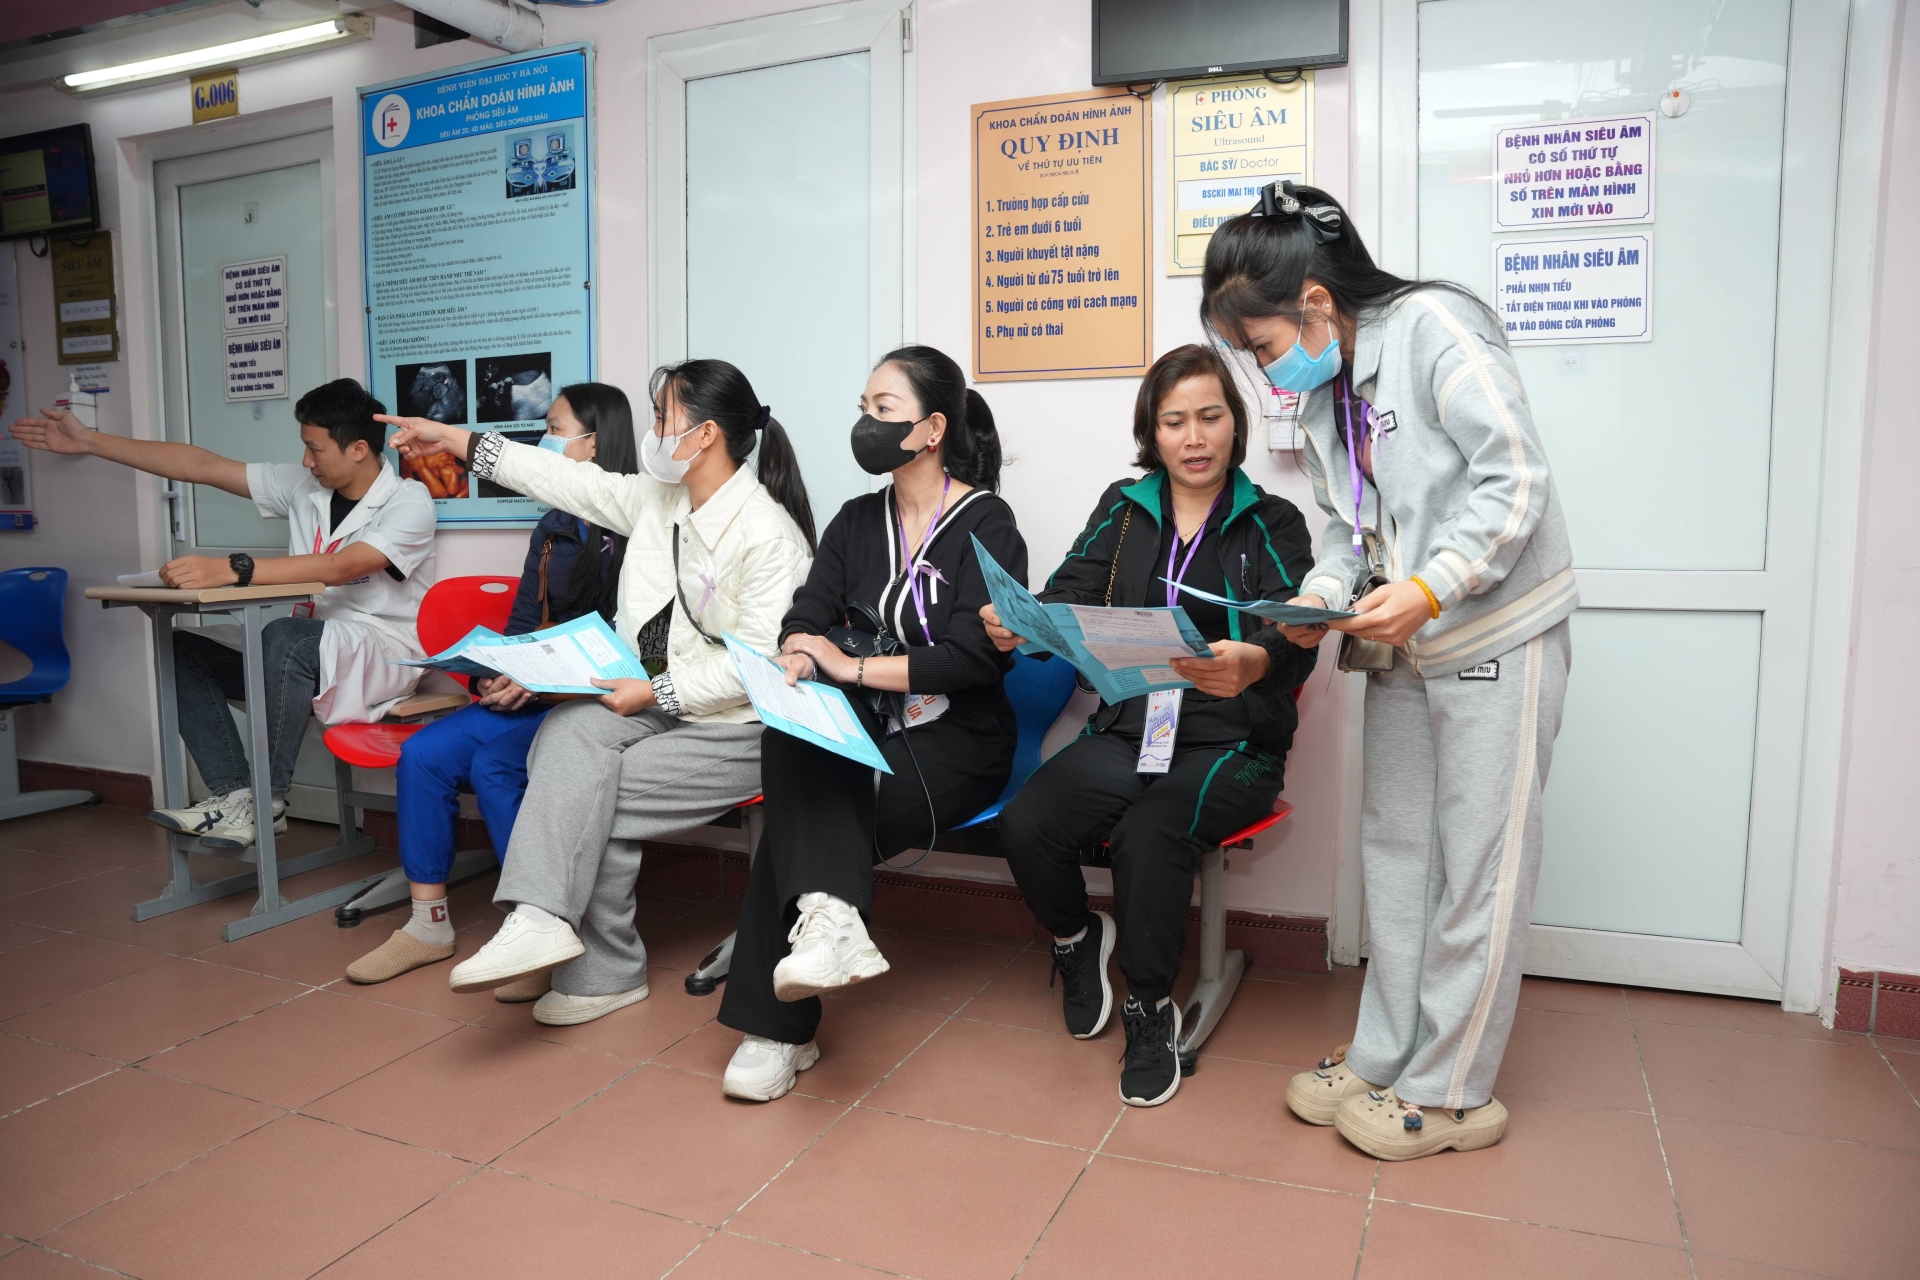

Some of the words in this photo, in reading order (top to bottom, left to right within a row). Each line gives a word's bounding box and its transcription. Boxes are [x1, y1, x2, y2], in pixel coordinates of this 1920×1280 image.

[437, 84, 456, 94] BỆNH
[459, 80, 476, 89] VIỆN
[478, 76, 492, 86] ĐẠI
[495, 73, 510, 83] HỌC
[520, 68, 531, 77] HÀ
[534, 64, 548, 75] NỘI
[195, 80, 234, 110] G.006
[416, 103, 445, 120] KHOA
[448, 91, 478, 113] CHẨN
[482, 88, 514, 106] ĐOÁN
[518, 83, 545, 100] HÌNH
[548, 77, 574, 94] ẢNH
[1212, 86, 1267, 103] PHÒNG
[466, 111, 490, 122] PHÒNG
[492, 107, 505, 117] SIÊU
[507, 106, 518, 114] ÂM
[990, 118, 1016, 130] KHOA
[1020, 111, 1047, 126] CHẨN
[1050, 110, 1079, 123] ĐOÁN
[1083, 108, 1106, 119] HÌNH
[1110, 104, 1131, 116] ẢNH
[1191, 110, 1243, 133] SIÊU
[1250, 106, 1287, 126] ÂM
[1001, 134, 1051, 160] QUY
[1058, 127, 1119, 153] ĐỊNH
[1214, 134, 1265, 146] Ultrasound
[1506, 134, 1539, 149] BỆNH
[1544, 130, 1580, 145] NHÂN
[1585, 127, 1615, 141] SIÊU
[1620, 125, 1641, 138] ÂM
[1018, 160, 1029, 171] VỀ
[1033, 159, 1050, 169] THỨ
[1053, 158, 1064, 168] TỰ
[1067, 158, 1079, 166] ƯU
[1082, 155, 1102, 165] TIÊN
[1529, 150, 1545, 164] CÓ
[1550, 147, 1567, 162] SỐ
[1572, 147, 1597, 160] THỨ
[1600, 146, 1618, 160] TỰ
[1200, 160, 1219, 172] BÁC
[1240, 158, 1279, 169] Doctor
[1504, 169, 1530, 184] NHỎ
[1535, 170, 1561, 182] HƠN
[1566, 165, 1601, 181] HOẶC
[1606, 161, 1642, 177] BẰNG
[987, 201, 994, 212] 1.
[997, 197, 1028, 211] Trường
[1032, 197, 1049, 211] hợp
[1052, 191, 1069, 208] cấp
[1072, 191, 1089, 205] cứu
[1202, 189, 1226, 198] BSCKII
[1228, 188, 1241, 196] MAI
[1244, 187, 1255, 197] THỊ
[1510, 186, 1528, 202] SỐ
[1531, 186, 1564, 200] TRÊN
[1569, 184, 1599, 197] MÀN
[1604, 182, 1635, 195] HÌNH
[1532, 207, 1554, 218] XIN
[1558, 204, 1583, 216] MỜI
[1588, 202, 1613, 215] VÀO
[986, 226, 994, 237] 2.
[997, 222, 1011, 236] Trẻ
[1014, 224, 1028, 235] em
[1032, 221, 1051, 234] dưới
[1055, 220, 1060, 232] 6
[1064, 216, 1081, 231] tuổi
[986, 251, 994, 262] 3.
[997, 247, 1024, 263] Người
[1027, 244, 1058, 260] khuyết
[1061, 245, 1074, 260] tật
[1076, 244, 1100, 259] nặng
[1504, 254, 1538, 274] BỆNH
[1543, 251, 1579, 269] NHÂN
[1584, 249, 1613, 267] SIÊU
[1617, 247, 1639, 265] ÂM
[226, 270, 239, 280] BỆNH
[241, 267, 256, 277] NHÂN
[258, 265, 269, 274] SIÊU
[986, 276, 994, 288] 4.
[997, 272, 1024, 288] Người
[1027, 272, 1036, 285] từ
[1067, 267, 1085, 282] tuổi
[1088, 267, 1101, 282] trở
[1104, 269, 1119, 281] lên
[1506, 281, 1526, 294] PHẢI
[1529, 283, 1550, 294] NHỊN
[1553, 278, 1571, 292] TIỂU
[986, 301, 994, 313] 5.
[997, 297, 1024, 313] Người
[1027, 297, 1037, 311] có
[1041, 297, 1064, 311] công
[1067, 296, 1081, 308] với
[1110, 294, 1137, 309] mạng
[1506, 300, 1520, 312] TẮT
[1524, 300, 1543, 314] ĐIỆN
[1547, 301, 1571, 312] THOẠI
[1574, 300, 1588, 309] KHI
[1591, 298, 1608, 309] VÀO
[1611, 296, 1641, 308] PHÒNG
[986, 326, 994, 338] 6.
[997, 325, 1014, 340] Phụ
[1017, 323, 1029, 337] nữ
[1032, 323, 1042, 336] có
[1046, 323, 1063, 335] thai
[1506, 321, 1517, 331] RA
[1520, 319, 1536, 330] VÀO
[1539, 318, 1562, 330] ĐÓNG
[1565, 316, 1582, 329] CỬA
[1586, 316, 1615, 328] PHÒNG
[229, 342, 242, 356] BỆNH
[244, 340, 258, 352] NHÂN
[260, 339, 271, 351] SIÊU
[273, 338, 281, 349] ÂM
